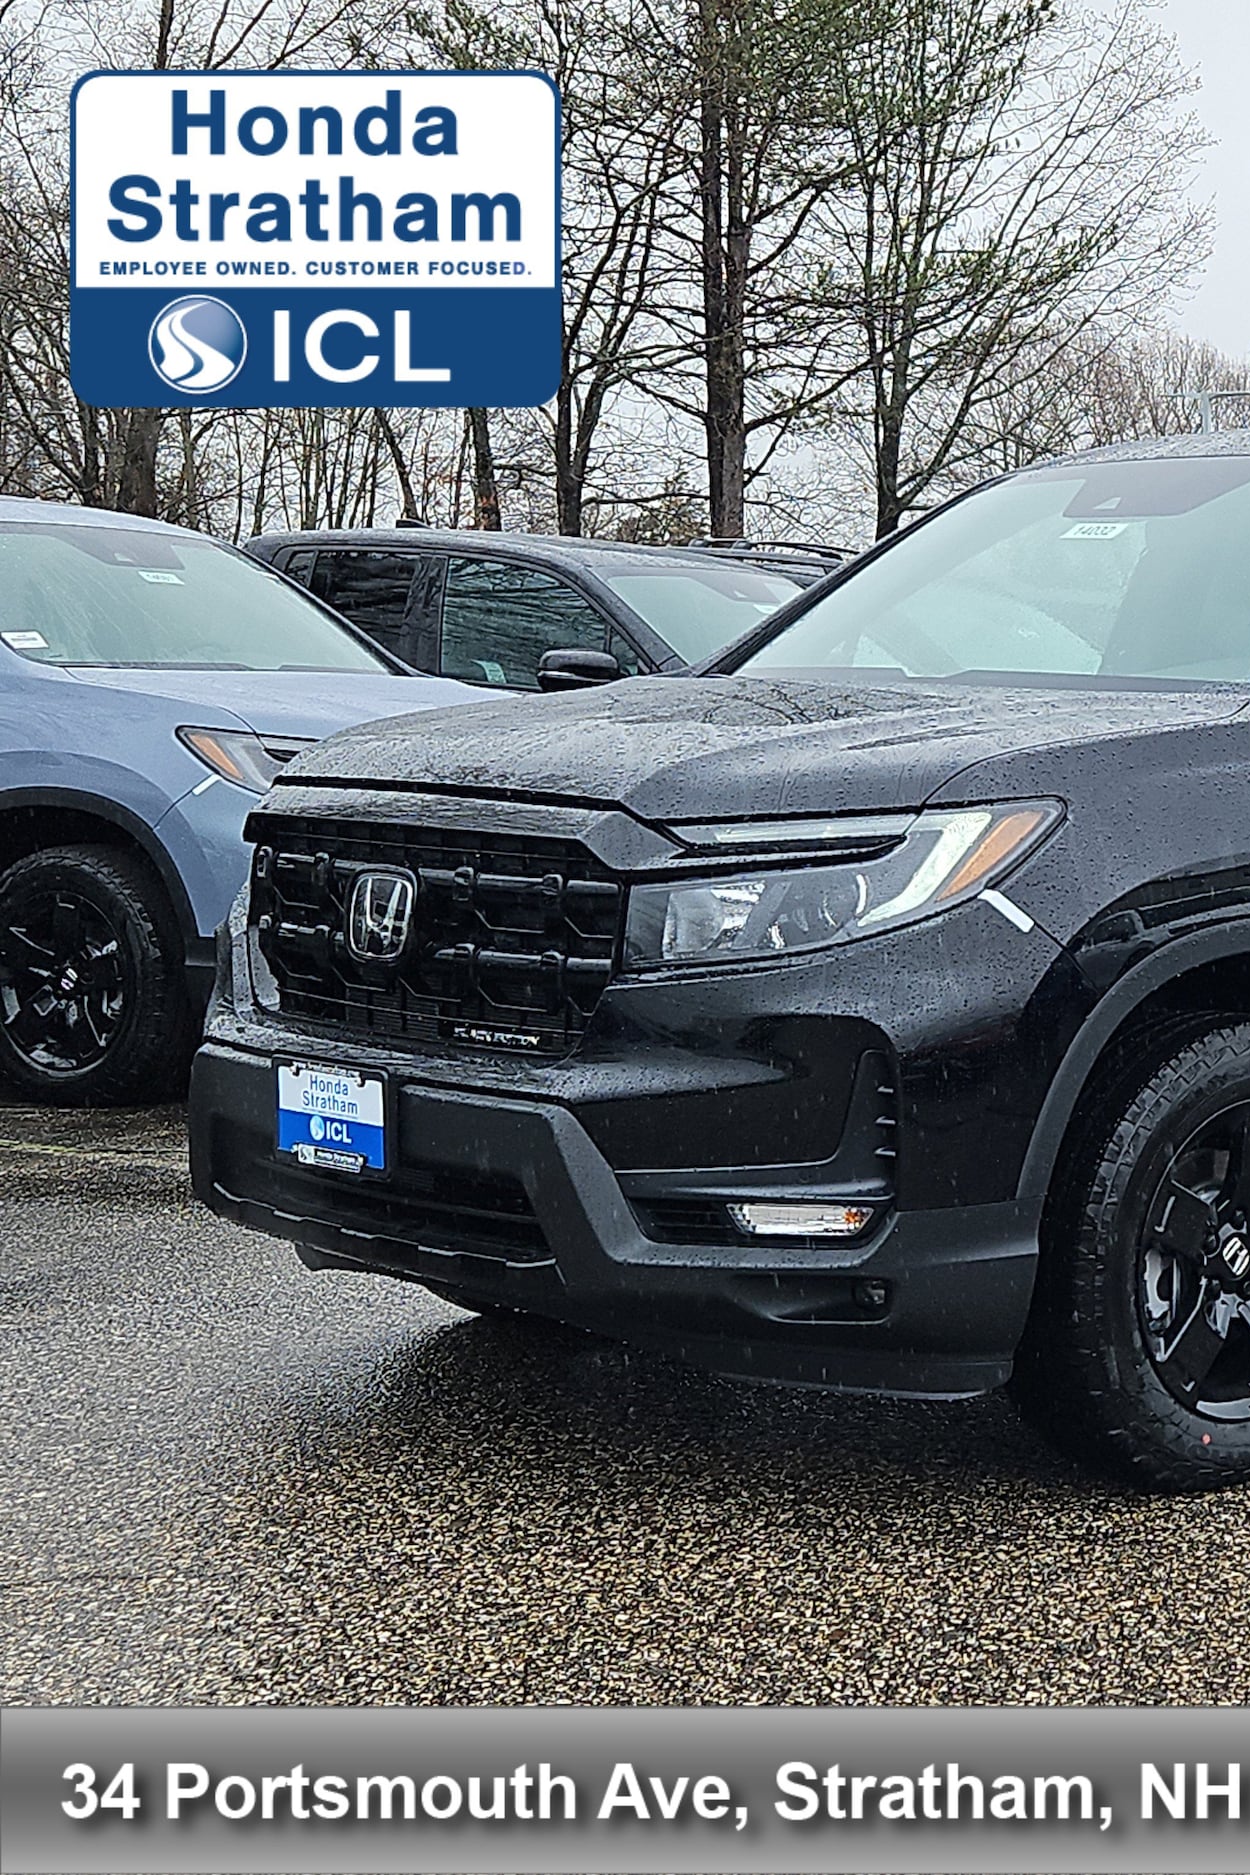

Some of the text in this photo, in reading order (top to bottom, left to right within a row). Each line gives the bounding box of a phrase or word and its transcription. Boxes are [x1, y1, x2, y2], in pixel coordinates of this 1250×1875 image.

[309, 1074, 349, 1096] Honda
[302, 1090, 358, 1115] Stratham
[326, 1120, 353, 1144] ICL
